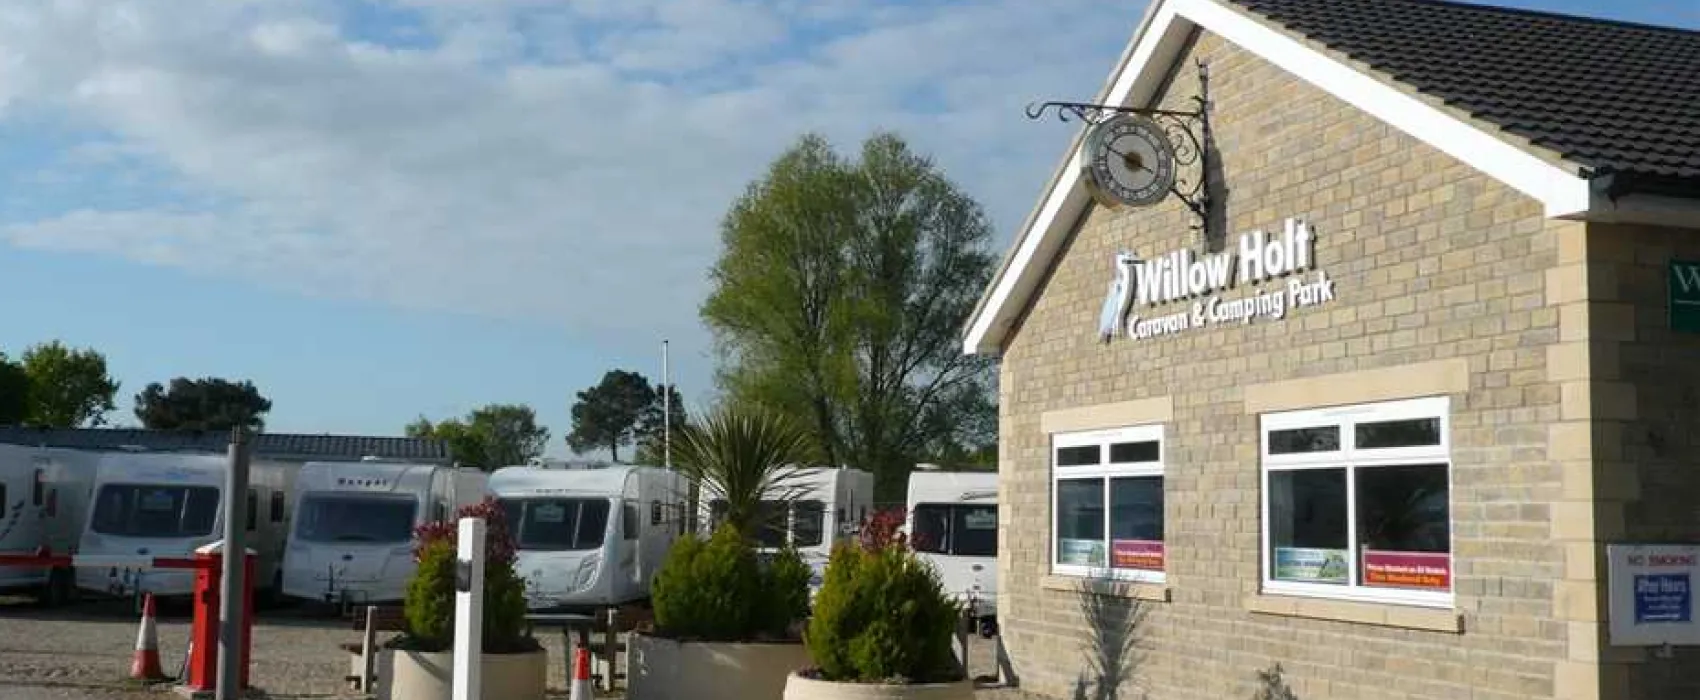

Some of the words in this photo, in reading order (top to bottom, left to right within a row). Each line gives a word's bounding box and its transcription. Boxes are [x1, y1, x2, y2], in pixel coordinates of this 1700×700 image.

[1137, 249, 1230, 304] Willow
[1240, 217, 1311, 281] Holt
[1128, 312, 1189, 339] Caravan
[1193, 302, 1206, 326] &
[1208, 290, 1284, 323] Camping
[1289, 271, 1333, 307] Park
